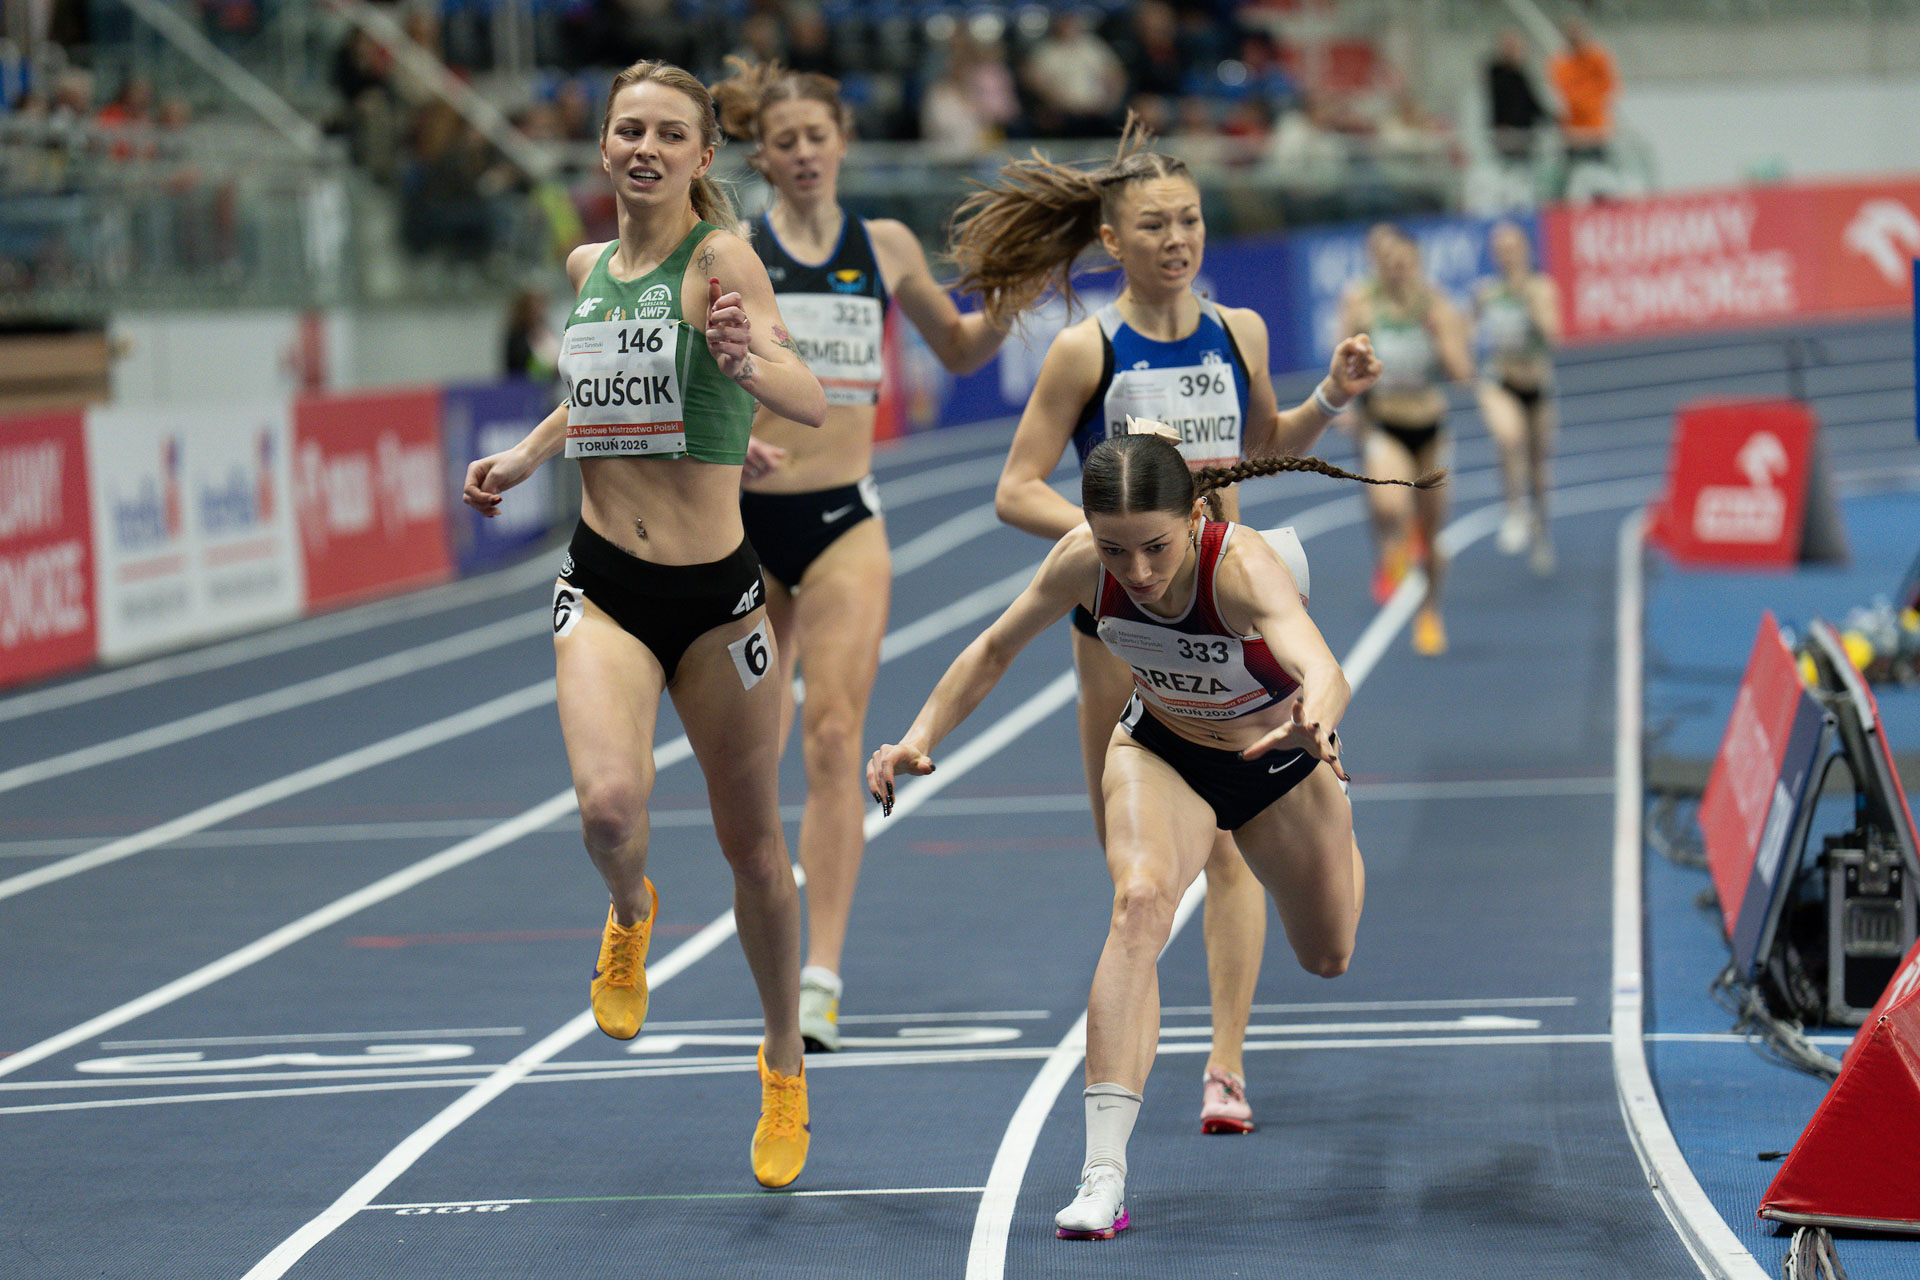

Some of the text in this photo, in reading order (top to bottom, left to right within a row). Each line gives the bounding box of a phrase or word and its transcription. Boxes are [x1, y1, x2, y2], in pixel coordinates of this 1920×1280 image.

[644, 290, 666, 301] AZS
[639, 307, 664, 318] AWF
[834, 302, 872, 325] 321
[617, 327, 663, 354] 146
[1179, 373, 1225, 397] 396
[580, 427, 607, 435] Halowe
[608, 425, 652, 434] Mistrzostwa
[654, 423, 679, 432] Polski
[577, 438, 648, 452] TORUŃ 2026
[553, 589, 575, 633] 6
[744, 632, 768, 676] 6
[1177, 638, 1229, 664] 333
[1237, 690, 1262, 704] Polski
[1204, 709, 1237, 718] 2026
